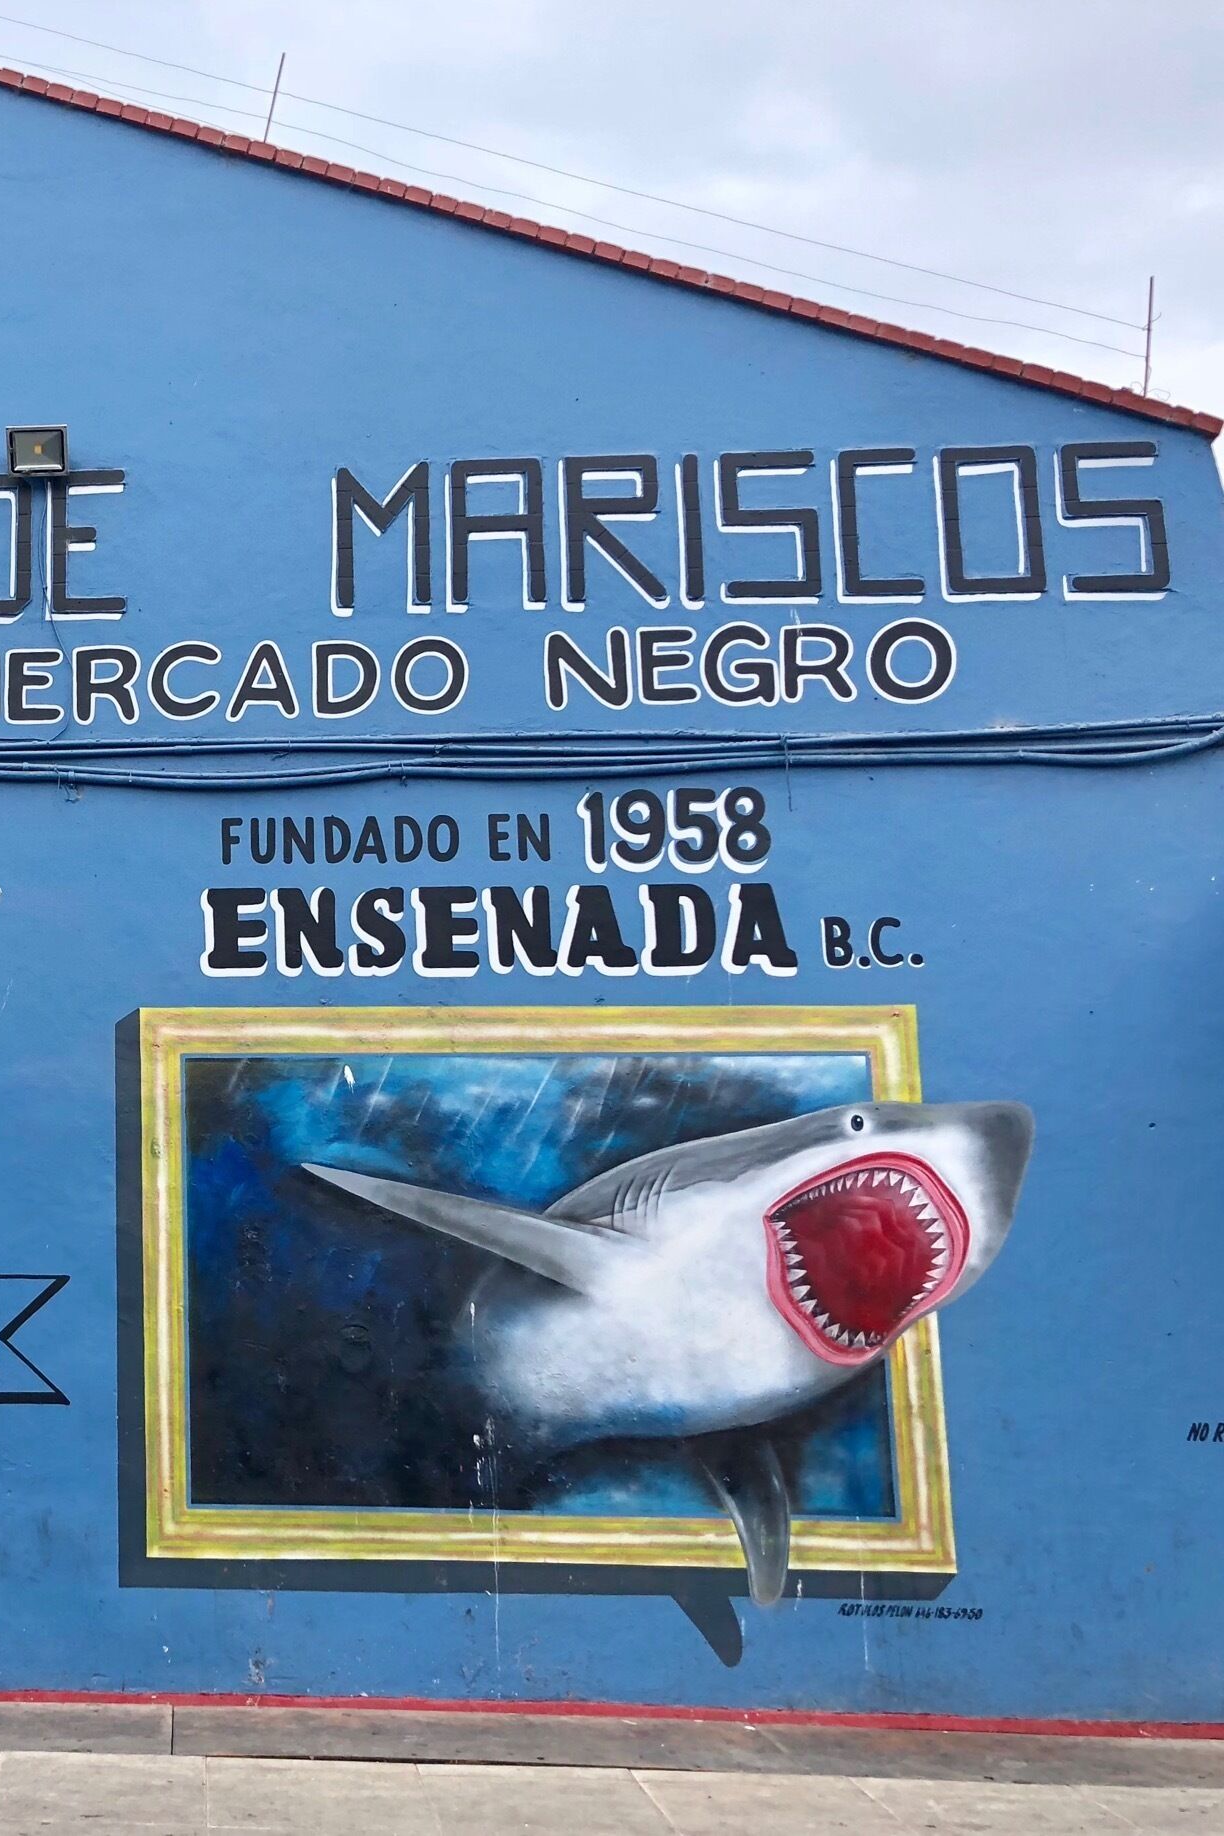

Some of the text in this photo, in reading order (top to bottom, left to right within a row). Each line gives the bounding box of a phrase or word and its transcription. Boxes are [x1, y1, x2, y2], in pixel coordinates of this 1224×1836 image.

[330, 439, 1175, 617] MARISCOS
[543, 617, 957, 712] NEGRO
[220, 786, 771, 874] FUNDADO EN 1958
[199, 882, 925, 978] ENSENADA B.C.
[1186, 1422, 1210, 1442] NO
